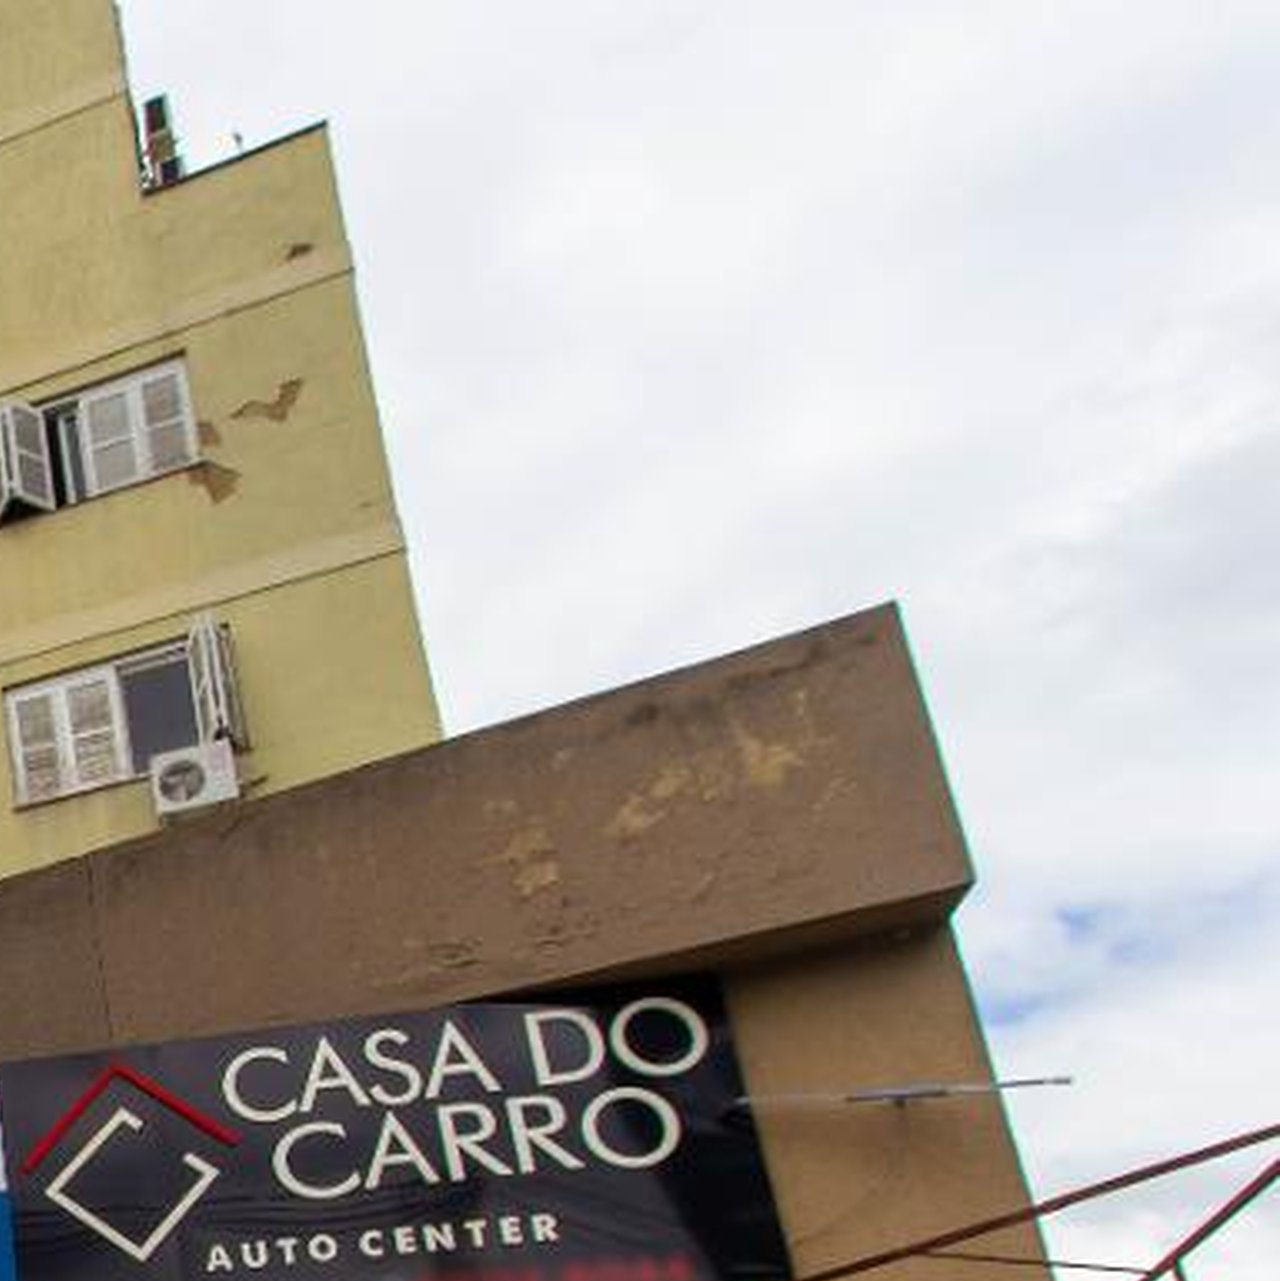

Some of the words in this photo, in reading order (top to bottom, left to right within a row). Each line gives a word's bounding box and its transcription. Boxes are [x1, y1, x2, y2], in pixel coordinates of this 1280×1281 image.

[220, 1018, 501, 1123] CASA
[523, 996, 710, 1087] DO
[271, 1086, 682, 1200] CARRO
[206, 1233, 339, 1273] AUTO
[358, 1212, 562, 1258] CENTER
